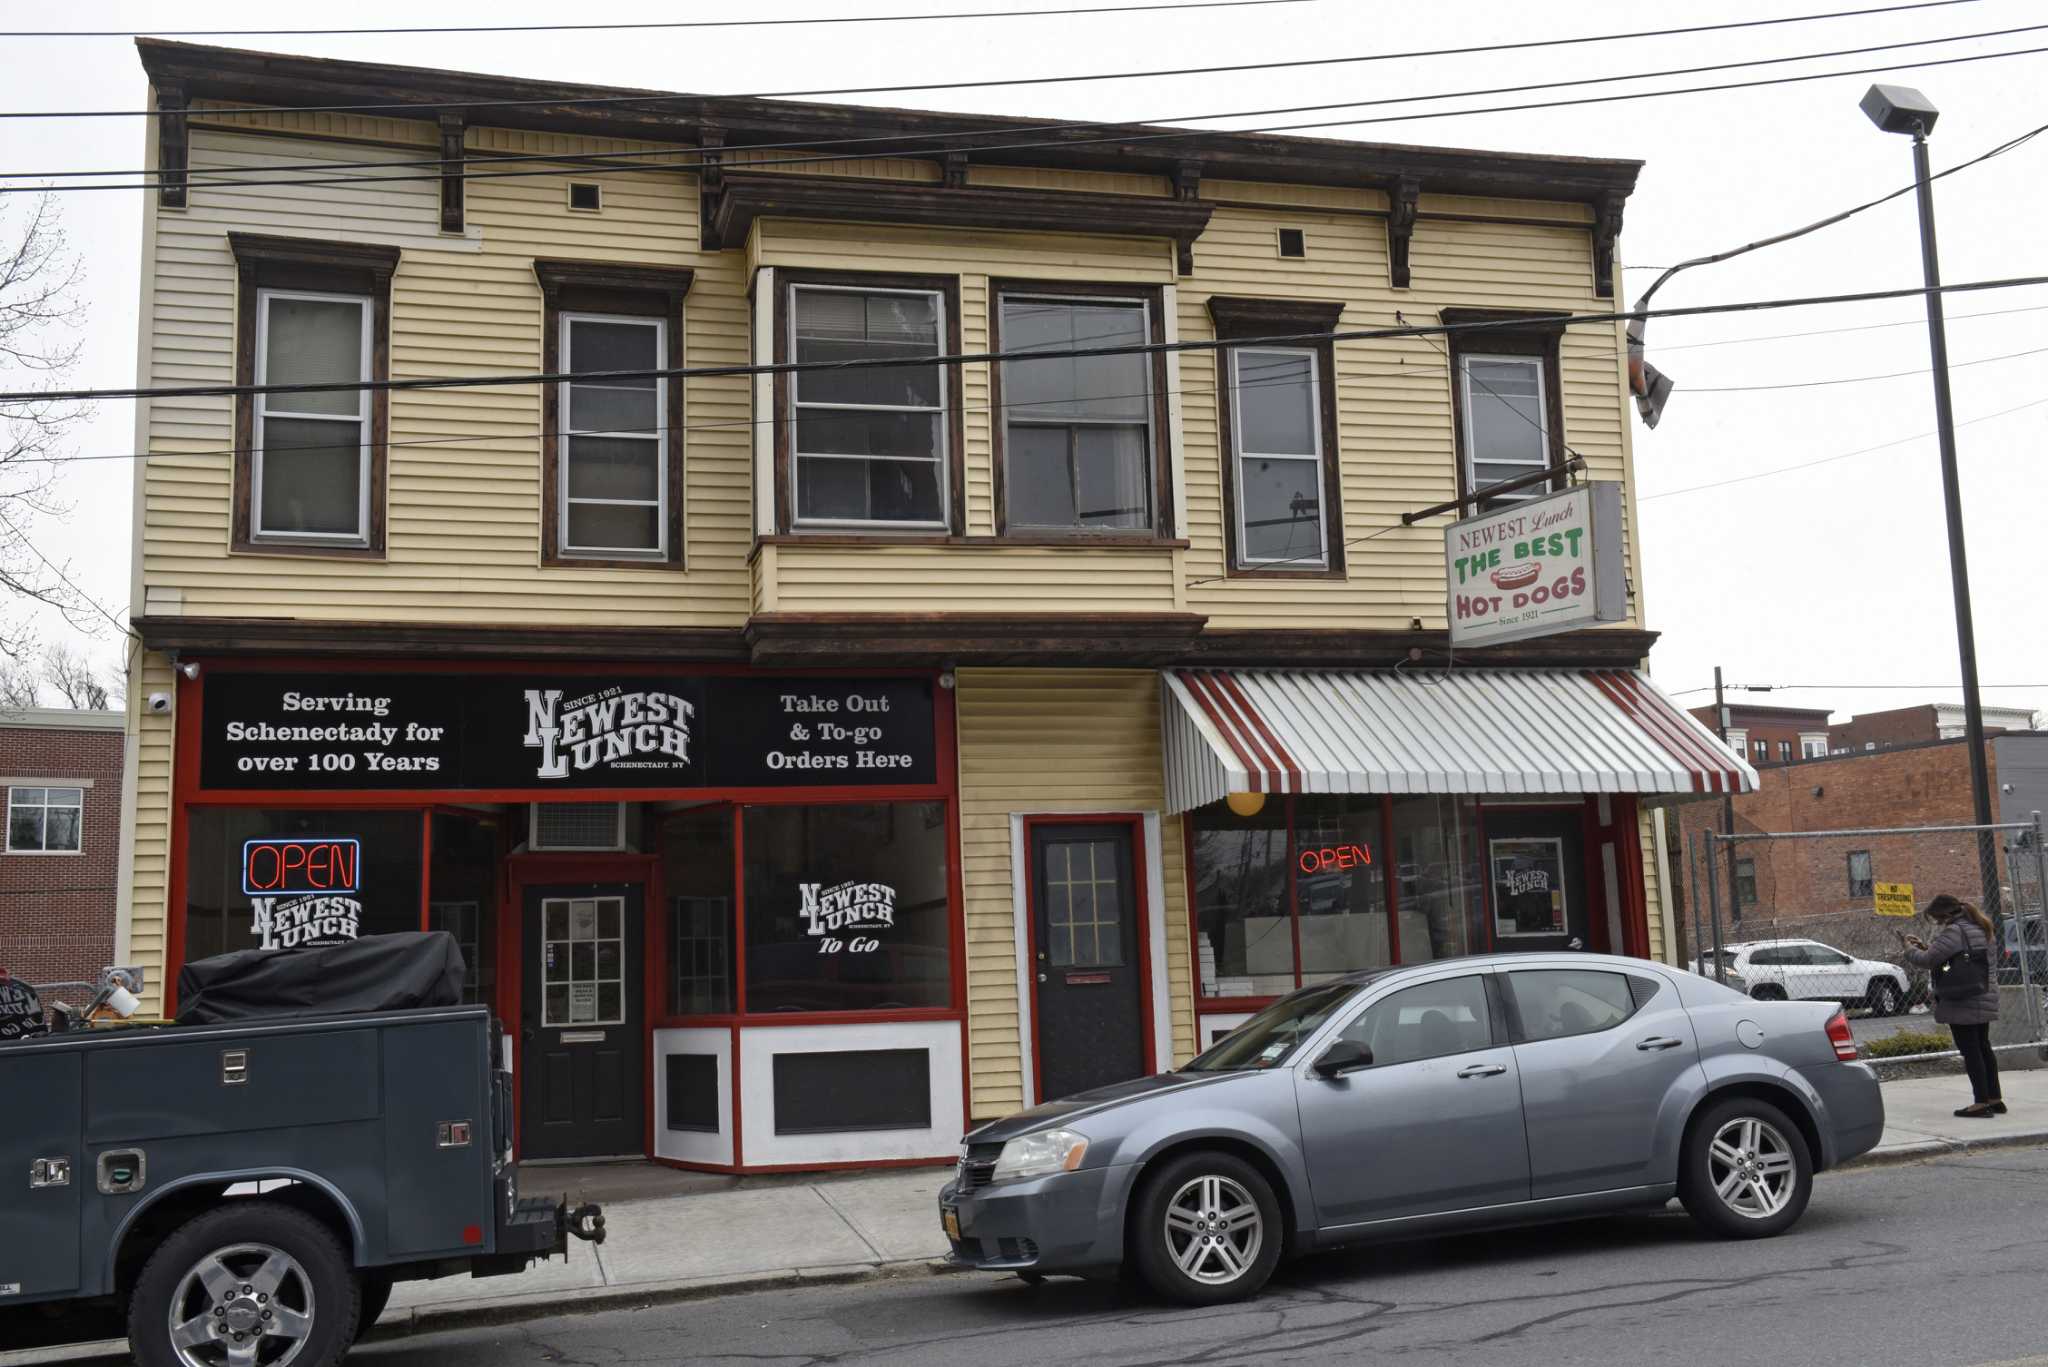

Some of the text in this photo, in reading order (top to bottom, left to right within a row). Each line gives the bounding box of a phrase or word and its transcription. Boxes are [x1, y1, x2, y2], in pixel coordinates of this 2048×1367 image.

[1460, 501, 1573, 551] NEWEST Lunch
[1455, 528, 1583, 584] THE BEST
[1456, 566, 1586, 619] HOT DOGS
[1499, 615, 1519, 626] Since
[282, 691, 391, 716] Serving
[563, 685, 622, 711] SINCE 1921
[780, 694, 890, 712] Take Out
[523, 689, 695, 747] NEWEST
[226, 721, 444, 746] Schenectady for
[790, 722, 882, 744] & To-go
[237, 752, 440, 771] over 100 Years
[537, 724, 691, 779] LUNCH
[766, 751, 913, 769] Orders Here
[249, 844, 354, 889] OPEN
[1299, 843, 1371, 873] OPEN
[1505, 870, 1549, 887] NEWEST
[1510, 879, 1549, 895] LUNCH
[799, 883, 896, 917] NEWEST
[250, 897, 362, 934] NEWEST
[808, 902, 895, 935] LUNCH
[259, 917, 359, 950] LUNCH
[818, 936, 880, 953] To Go
